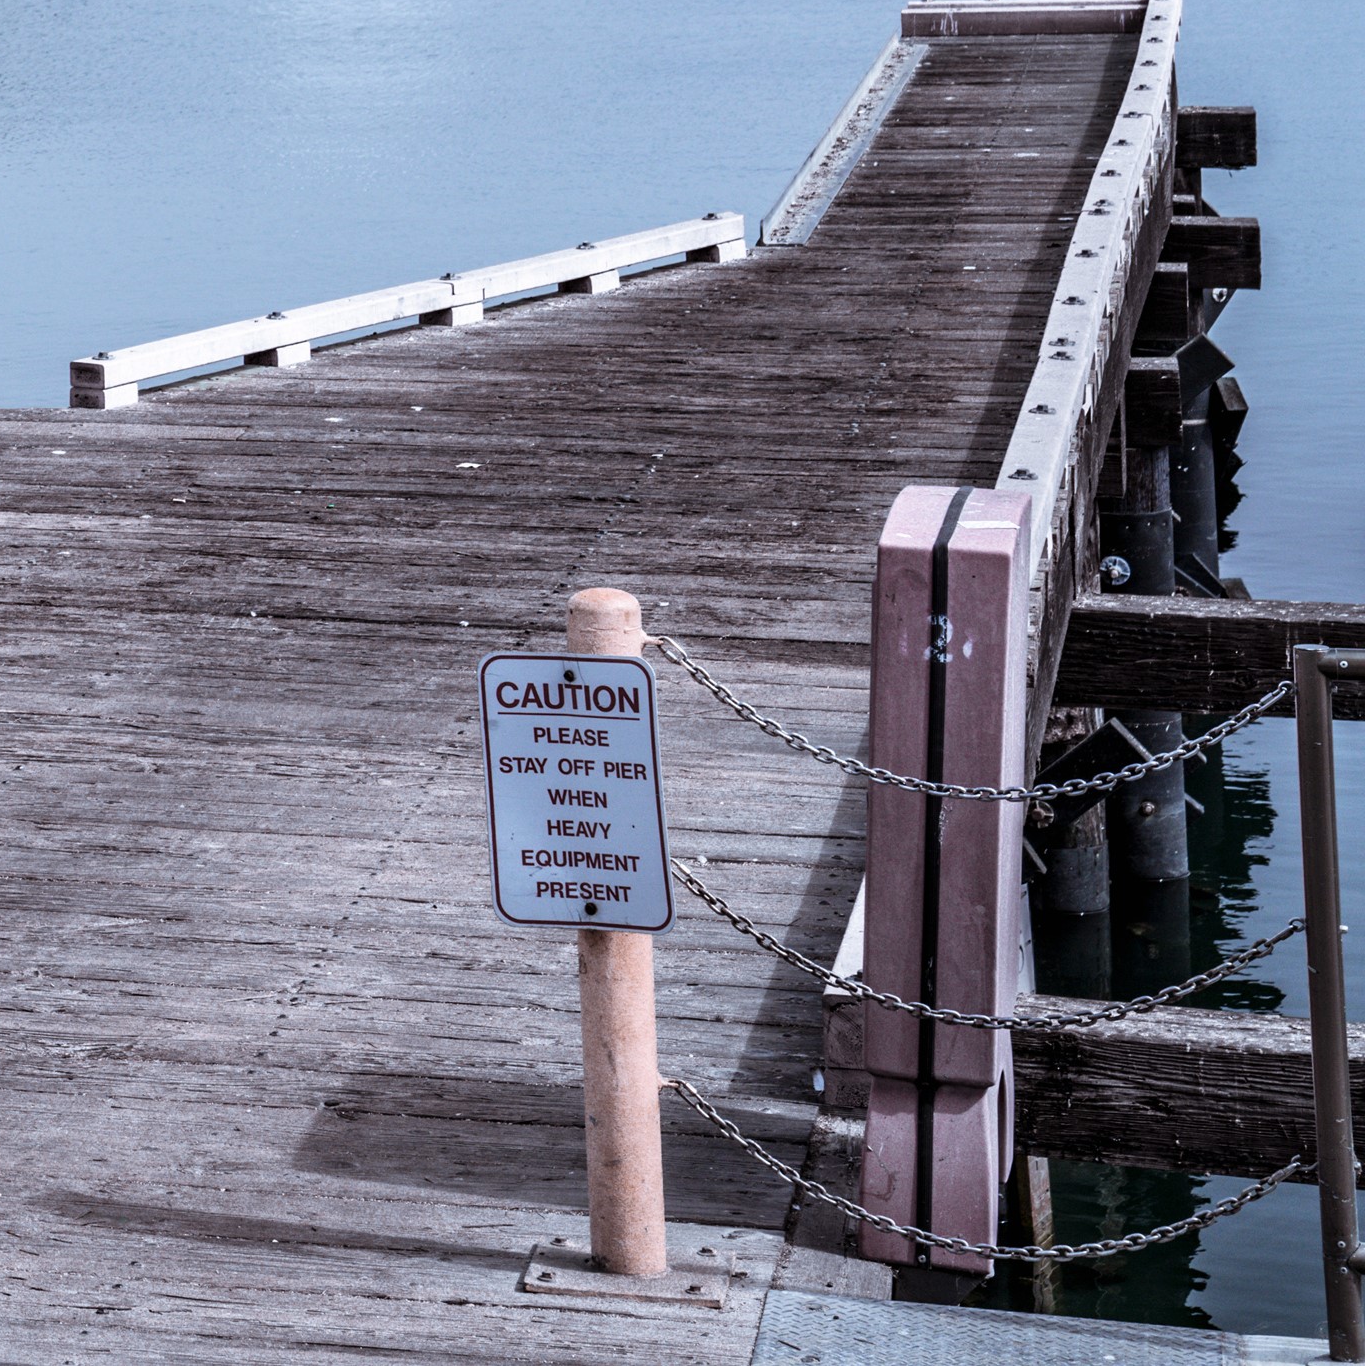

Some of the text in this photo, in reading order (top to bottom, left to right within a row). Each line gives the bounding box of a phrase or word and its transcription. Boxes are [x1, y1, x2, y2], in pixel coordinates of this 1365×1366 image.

[496, 681, 640, 714] CAUTION
[533, 727, 610, 747] PLEASE
[499, 756, 647, 780] STAY OFF PIER
[547, 788, 608, 808] WHEN
[547, 819, 611, 840] HEAVY
[521, 849, 640, 872] EQUIPMENT
[536, 881, 631, 903] PRESENT
